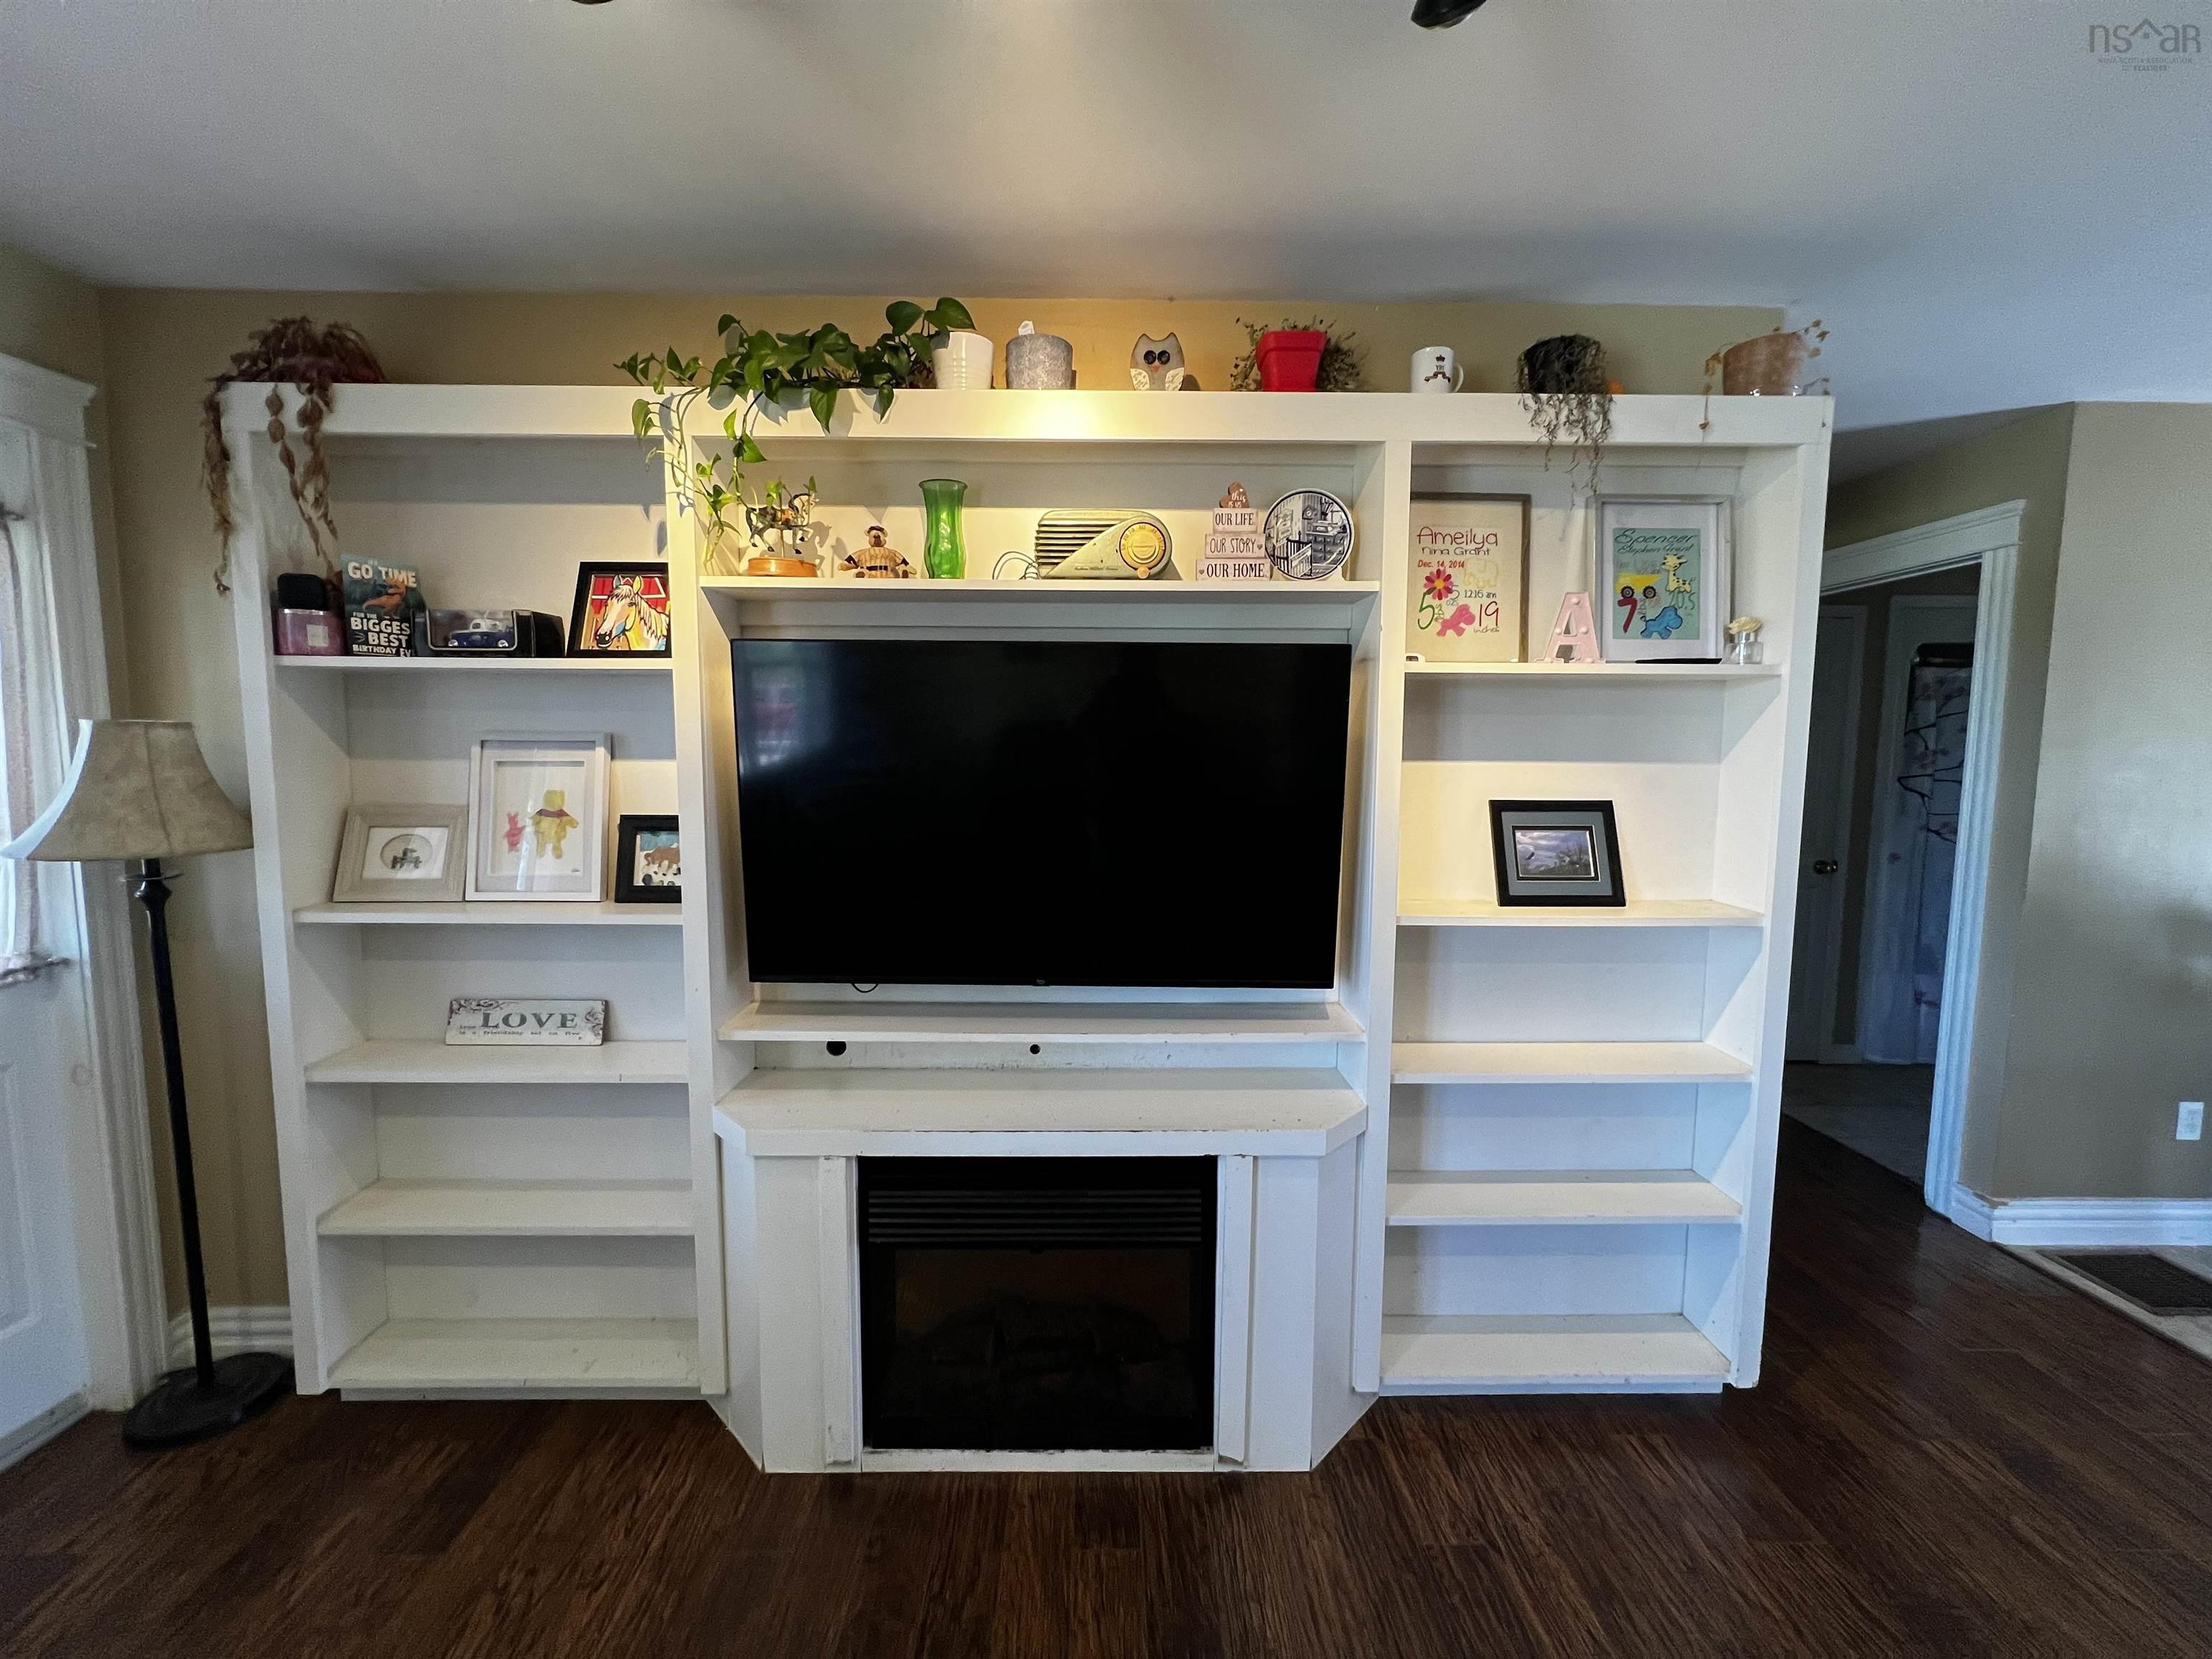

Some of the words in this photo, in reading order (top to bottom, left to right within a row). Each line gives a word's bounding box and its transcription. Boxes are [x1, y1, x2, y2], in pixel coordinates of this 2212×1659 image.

[1231, 490, 1246, 503] this
[1215, 512, 1232, 526] OUR
[1416, 526, 1498, 549] Ameilya
[1614, 529, 1698, 547] Spencer
[1210, 538, 1226, 554] OUR
[1454, 547, 1490, 556] Grant
[1206, 563, 1229, 578] OUR
[1418, 559, 1434, 567] Dec.
[1448, 559, 1465, 569] 2014
[348, 562, 373, 579] GO
[378, 565, 417, 588] TIME
[1479, 601, 1499, 627] 19
[1617, 596, 1638, 633] 7
[350, 617, 410, 634] BIGGES
[1543, 592, 1601, 663] A
[368, 631, 408, 647] BEST
[352, 644, 397, 654] BIRTHDAY
[480, 1012, 578, 1028] LOVE
